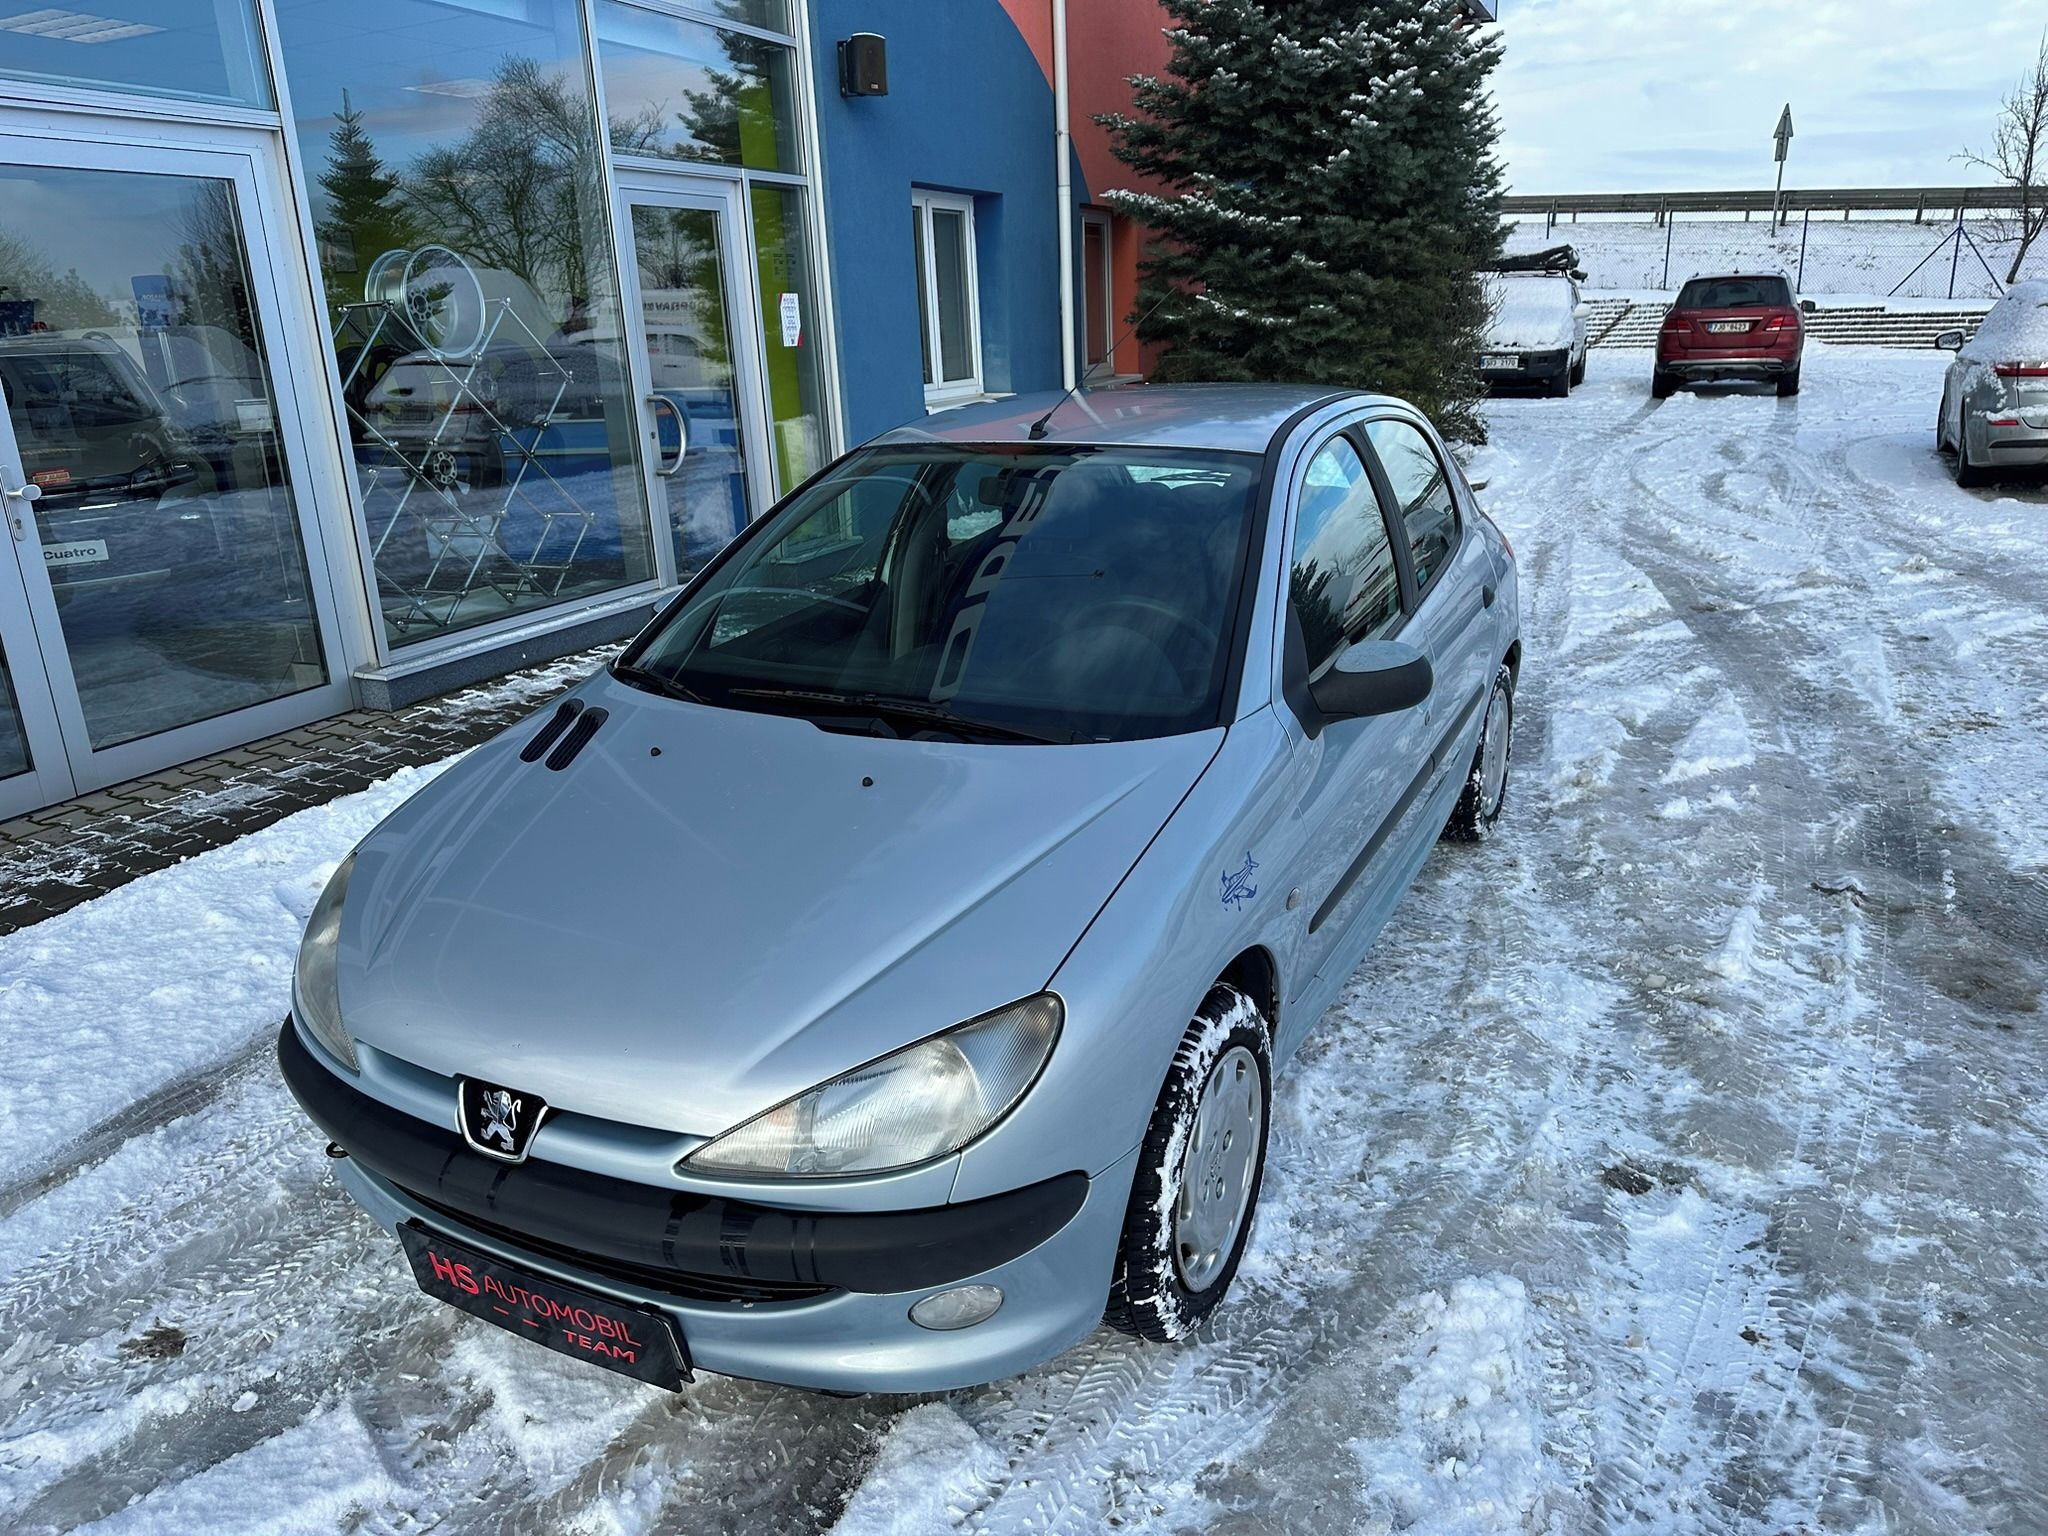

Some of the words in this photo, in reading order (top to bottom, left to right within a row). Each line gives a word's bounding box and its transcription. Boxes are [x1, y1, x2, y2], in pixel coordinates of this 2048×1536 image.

[43, 548, 97, 560] Cuatro
[427, 1251, 480, 1295] HS
[484, 1274, 642, 1348] AUTOMOBIL
[562, 1329, 636, 1364] TEAM
